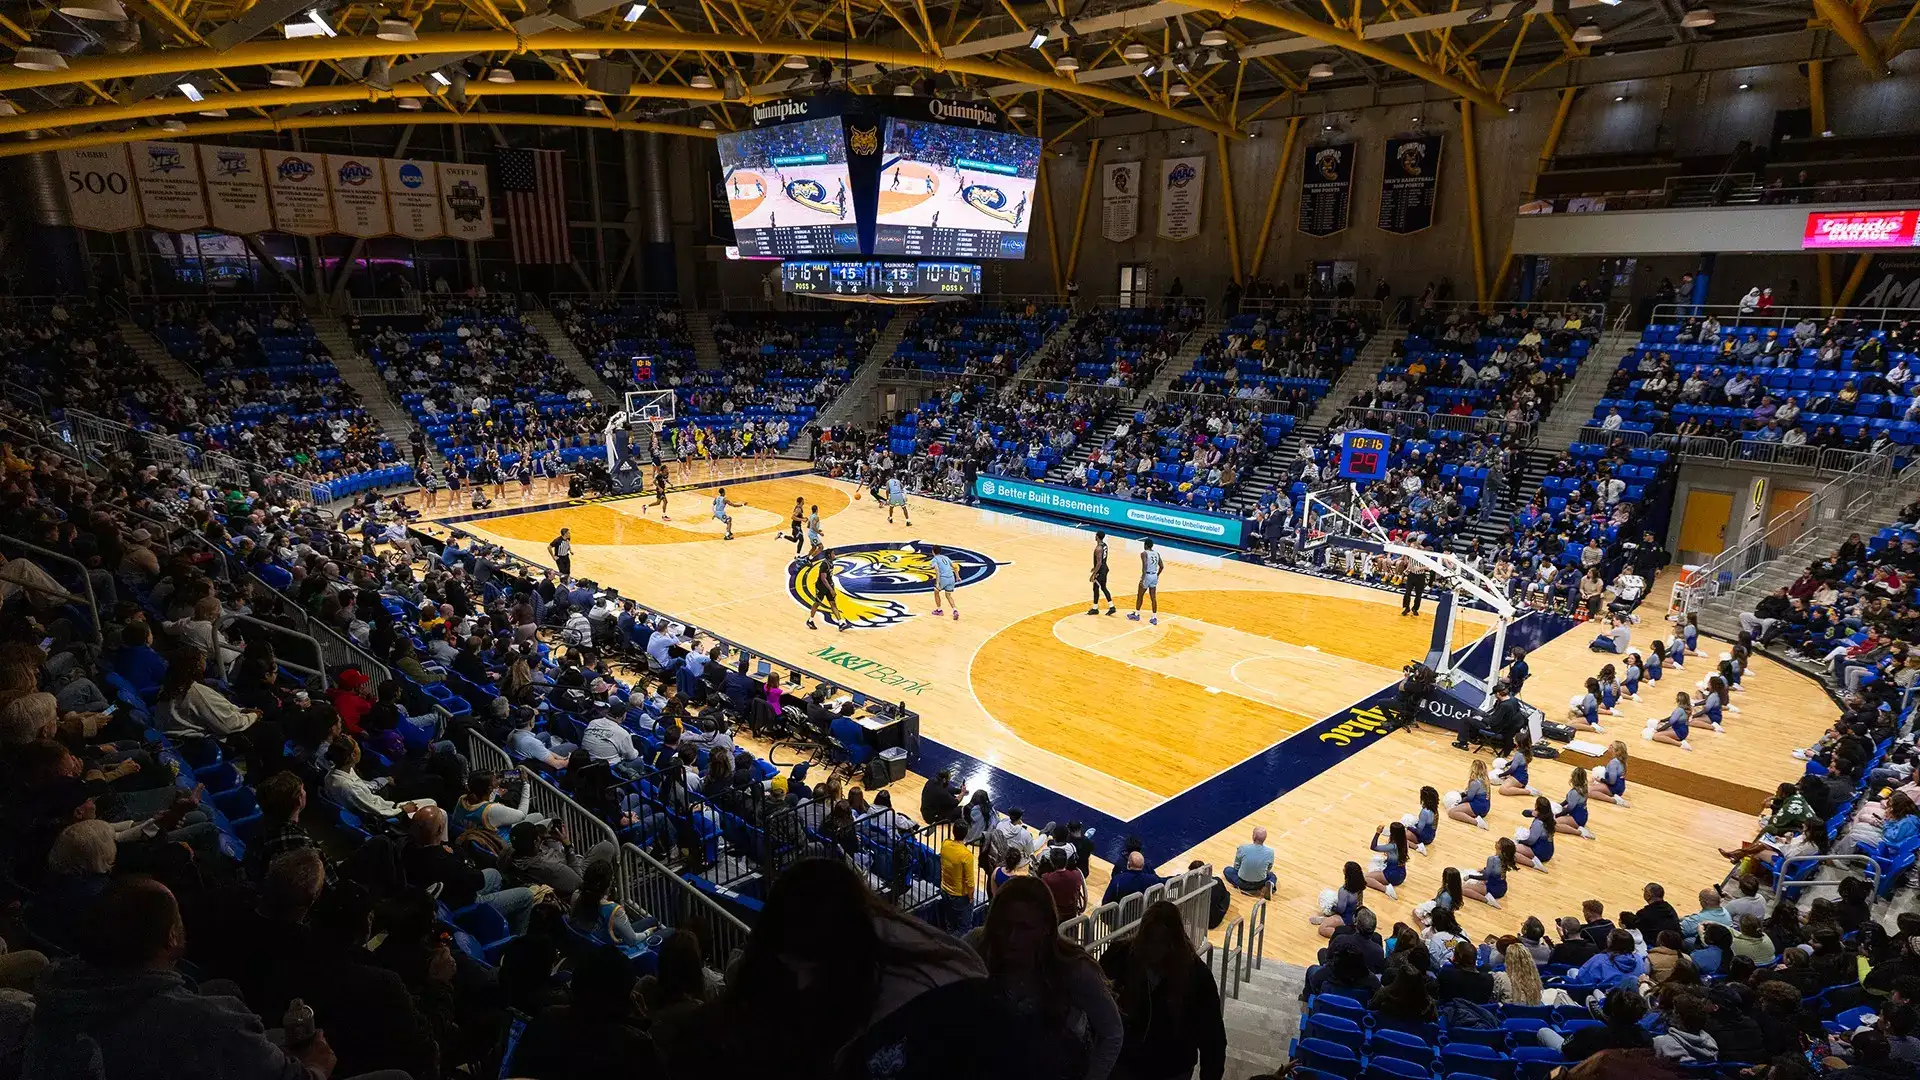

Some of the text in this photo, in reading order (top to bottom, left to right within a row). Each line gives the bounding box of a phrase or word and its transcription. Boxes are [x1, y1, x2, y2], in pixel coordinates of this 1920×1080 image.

[752, 99, 809, 125] Quinnipiac
[929, 99, 997, 126] Quinnipiac
[76, 150, 108, 159] FABBRI
[149, 155, 181, 167] NEC
[277, 162, 315, 181] MAAC
[338, 166, 373, 184] MAAC
[446, 168, 469, 176] SWEET
[1168, 167, 1197, 186] MAAC
[69, 171, 128, 195] 500
[402, 174, 423, 184] NCAA
[1828, 230, 1890, 241] GARAGE
[812, 264, 828, 272] HALF
[839, 268, 856, 280] 15
[891, 268, 908, 280] 15
[926, 265, 960, 282] 10:16
[795, 282, 810, 290] POSS
[903, 286, 909, 294] 3
[942, 284, 958, 292] POSS
[638, 368, 651, 381] 29
[1352, 437, 1383, 450] 10:16
[1350, 452, 1379, 473] 29
[998, 485, 1110, 516] Better Built Basements
[1130, 511, 1146, 519] From
[1146, 512, 1174, 525] Unfinished
[1182, 520, 1221, 533] Unbelievable!
[1150, 556, 1158, 565] 33
[807, 644, 933, 696] M&T Bank
[1428, 700, 1472, 720] QU.ed
